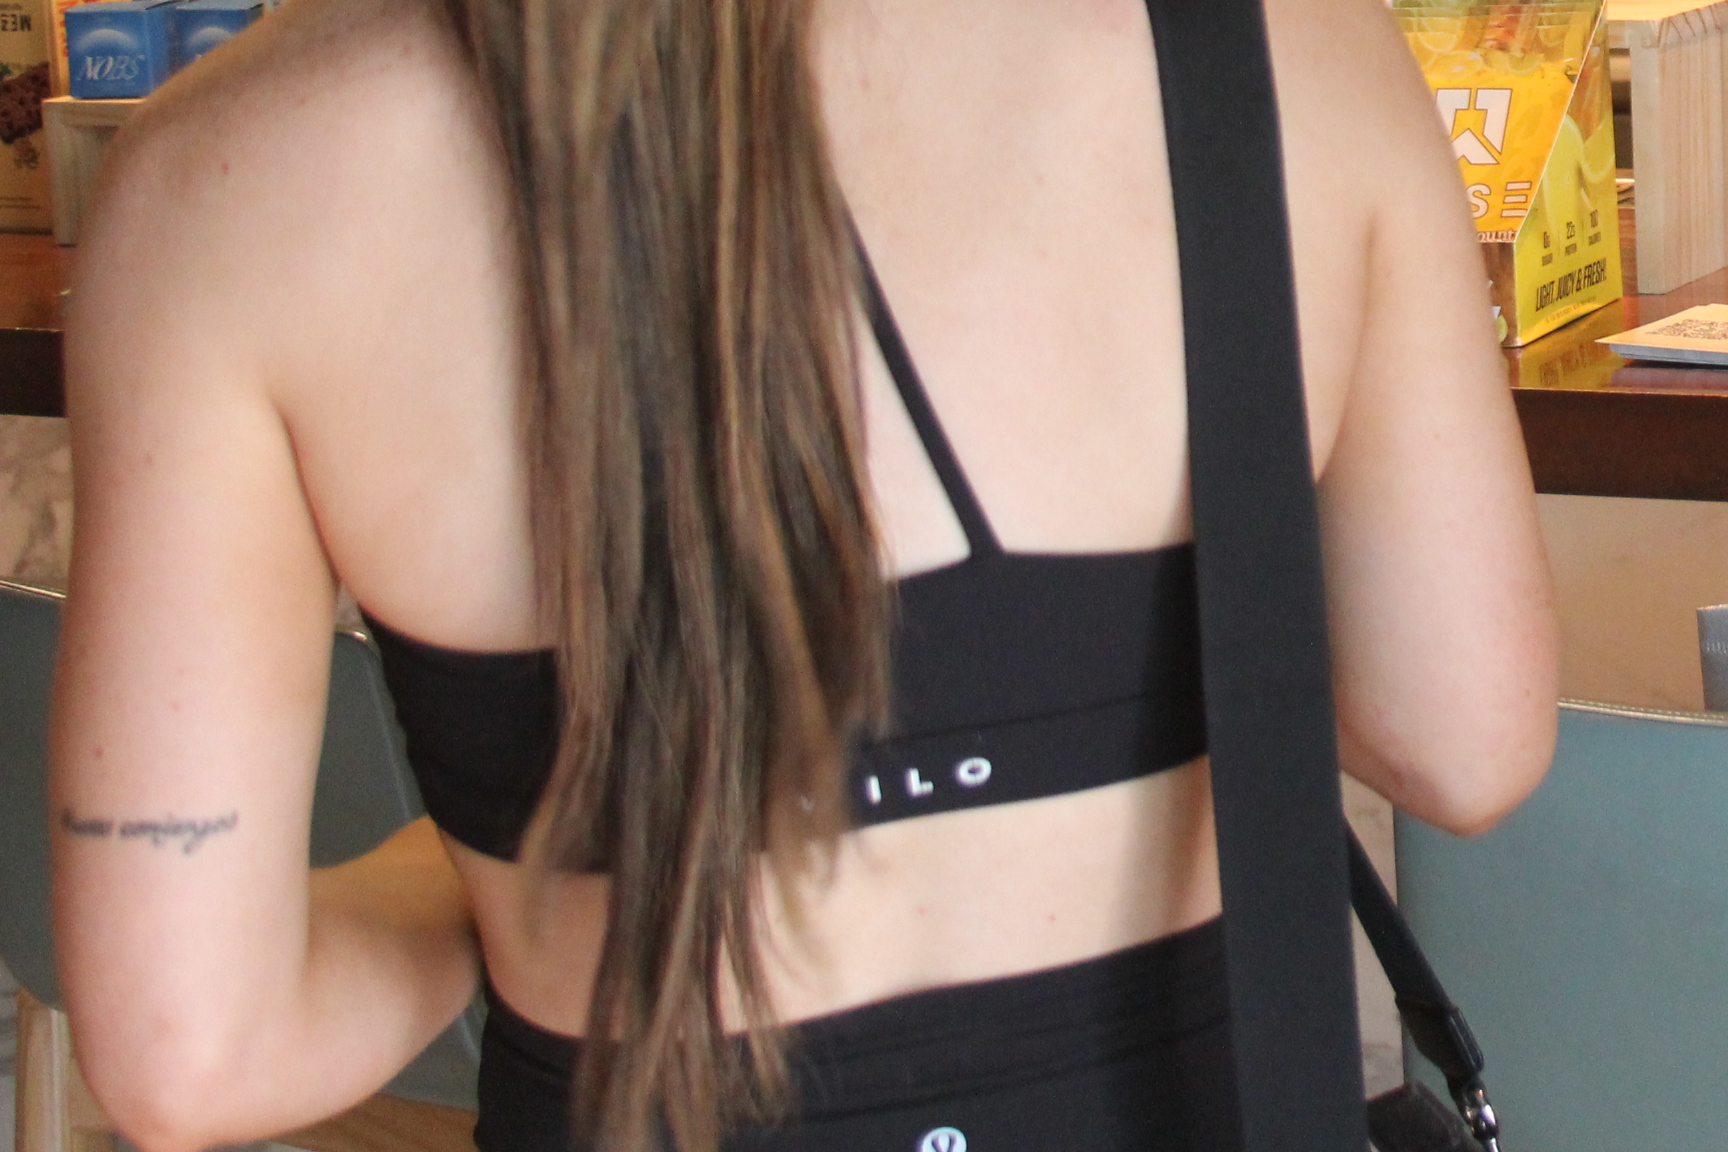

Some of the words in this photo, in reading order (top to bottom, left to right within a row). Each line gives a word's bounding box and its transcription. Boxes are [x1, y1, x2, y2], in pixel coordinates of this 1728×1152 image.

[1555, 269, 1576, 301] JUICY
[1576, 268, 1583, 292] &
[1583, 257, 1607, 289] FRESH!
